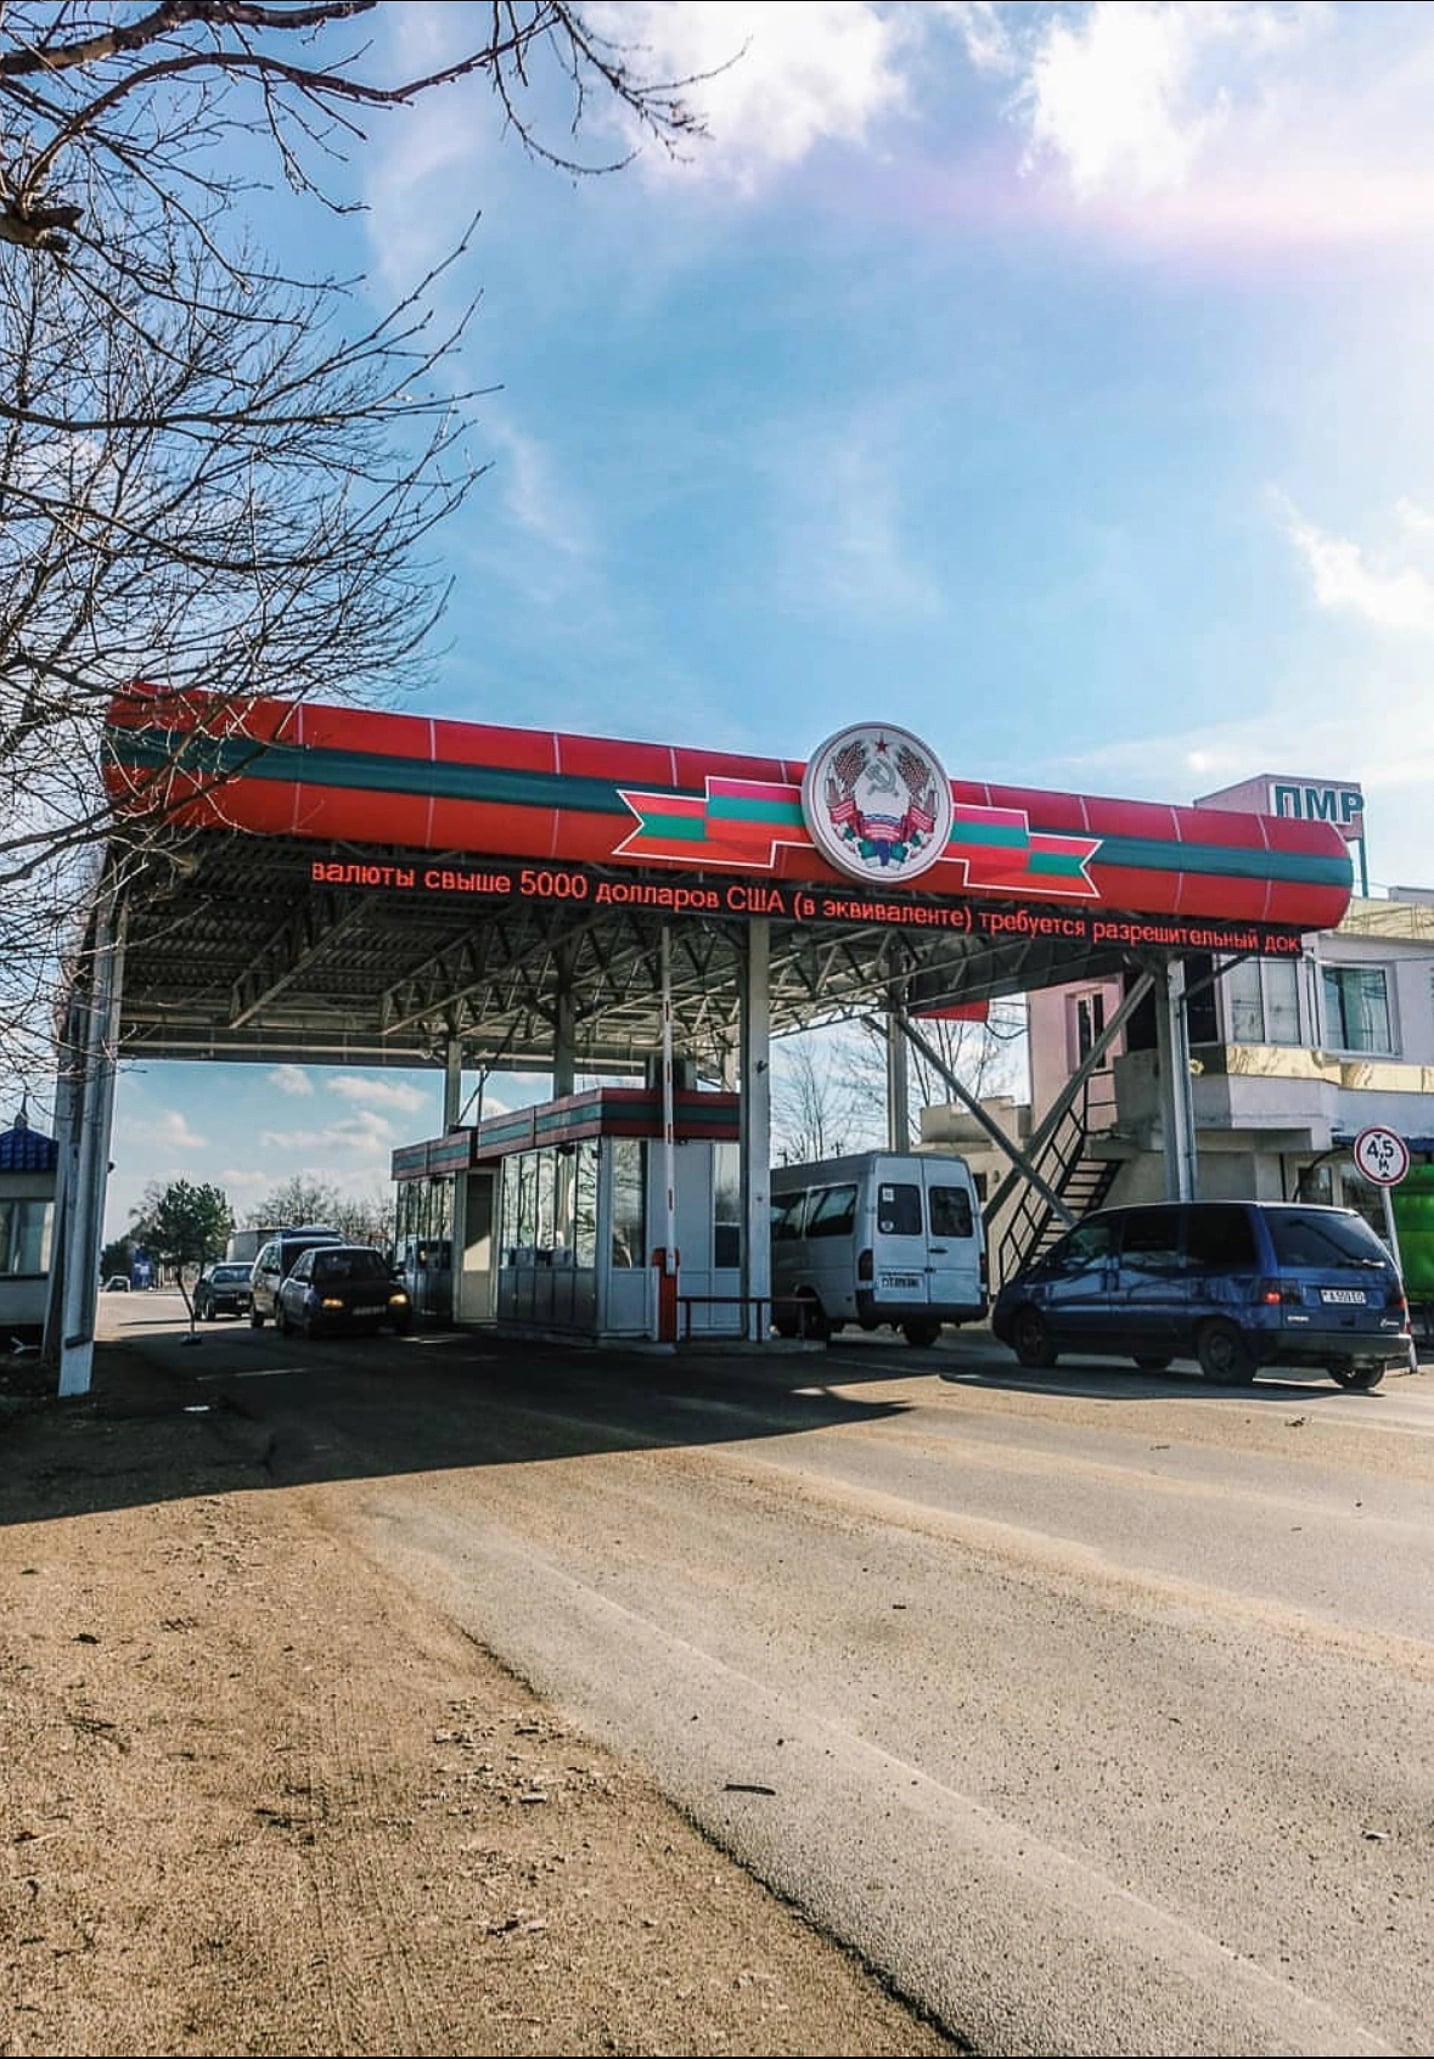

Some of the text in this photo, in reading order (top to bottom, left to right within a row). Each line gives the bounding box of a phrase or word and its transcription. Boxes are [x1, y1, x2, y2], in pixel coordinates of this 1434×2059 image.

[1275, 785, 1364, 822] ПМР
[311, 861, 415, 887] валюты
[424, 871, 511, 893] свыше
[519, 870, 588, 899] 5000
[597, 882, 719, 912] долларов
[726, 886, 785, 911] США
[793, 892, 816, 920] (в
[823, 899, 972, 932] эквиваленте)
[980, 909, 1086, 937] требуется
[1093, 921, 1259, 950] разрешительный
[1367, 1140, 1394, 1159] 4,5
